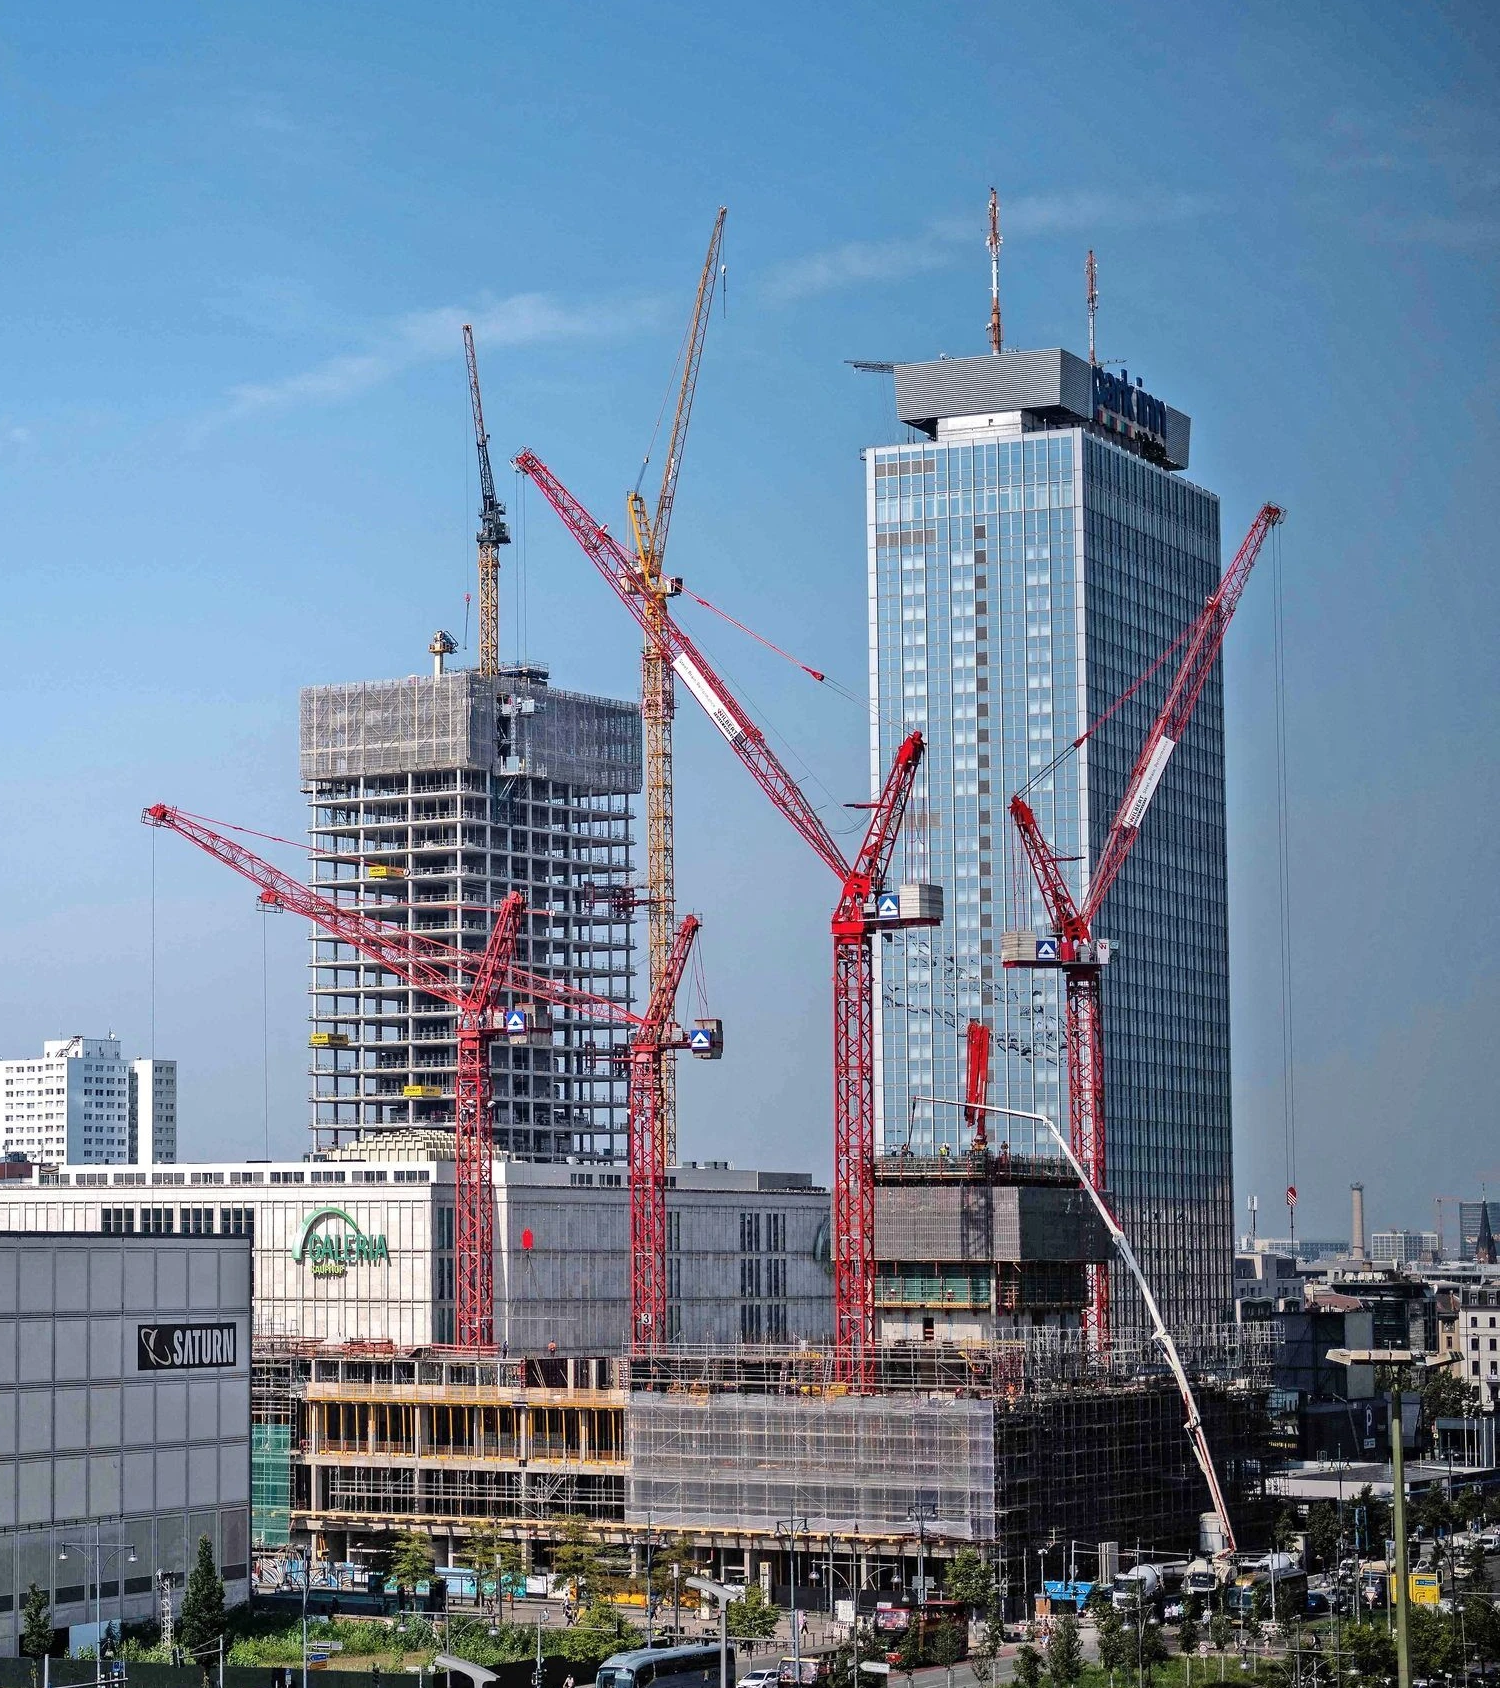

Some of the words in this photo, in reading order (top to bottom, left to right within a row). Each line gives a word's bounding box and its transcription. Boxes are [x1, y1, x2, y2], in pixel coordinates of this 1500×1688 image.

[717, 707, 739, 735] WILBERT
[308, 1234, 388, 1263] GALERIA
[643, 1313, 650, 1324] 3
[173, 1328, 234, 1366] SATURN
